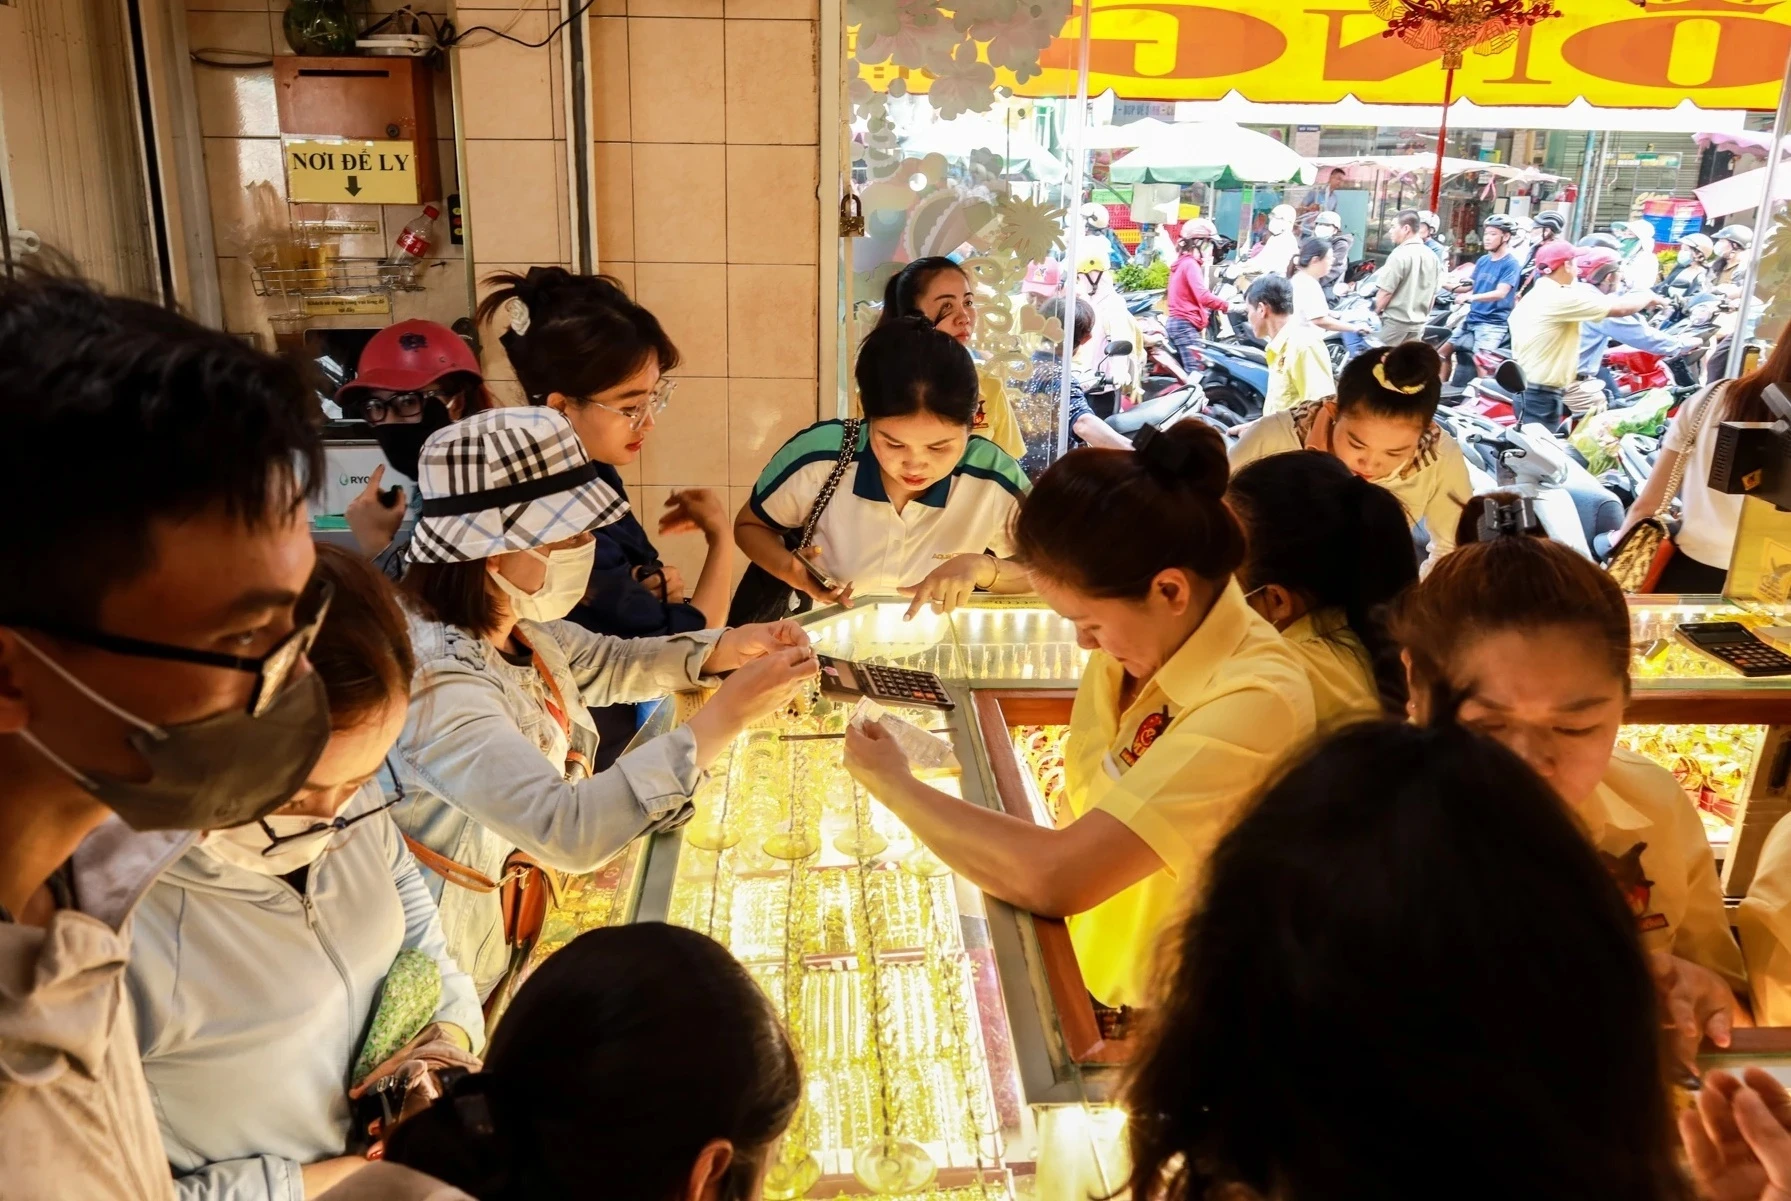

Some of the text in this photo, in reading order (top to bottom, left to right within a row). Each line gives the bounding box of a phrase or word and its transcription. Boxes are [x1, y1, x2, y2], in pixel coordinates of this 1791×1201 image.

[292, 148, 410, 171] NƠI ĐỂ LY
